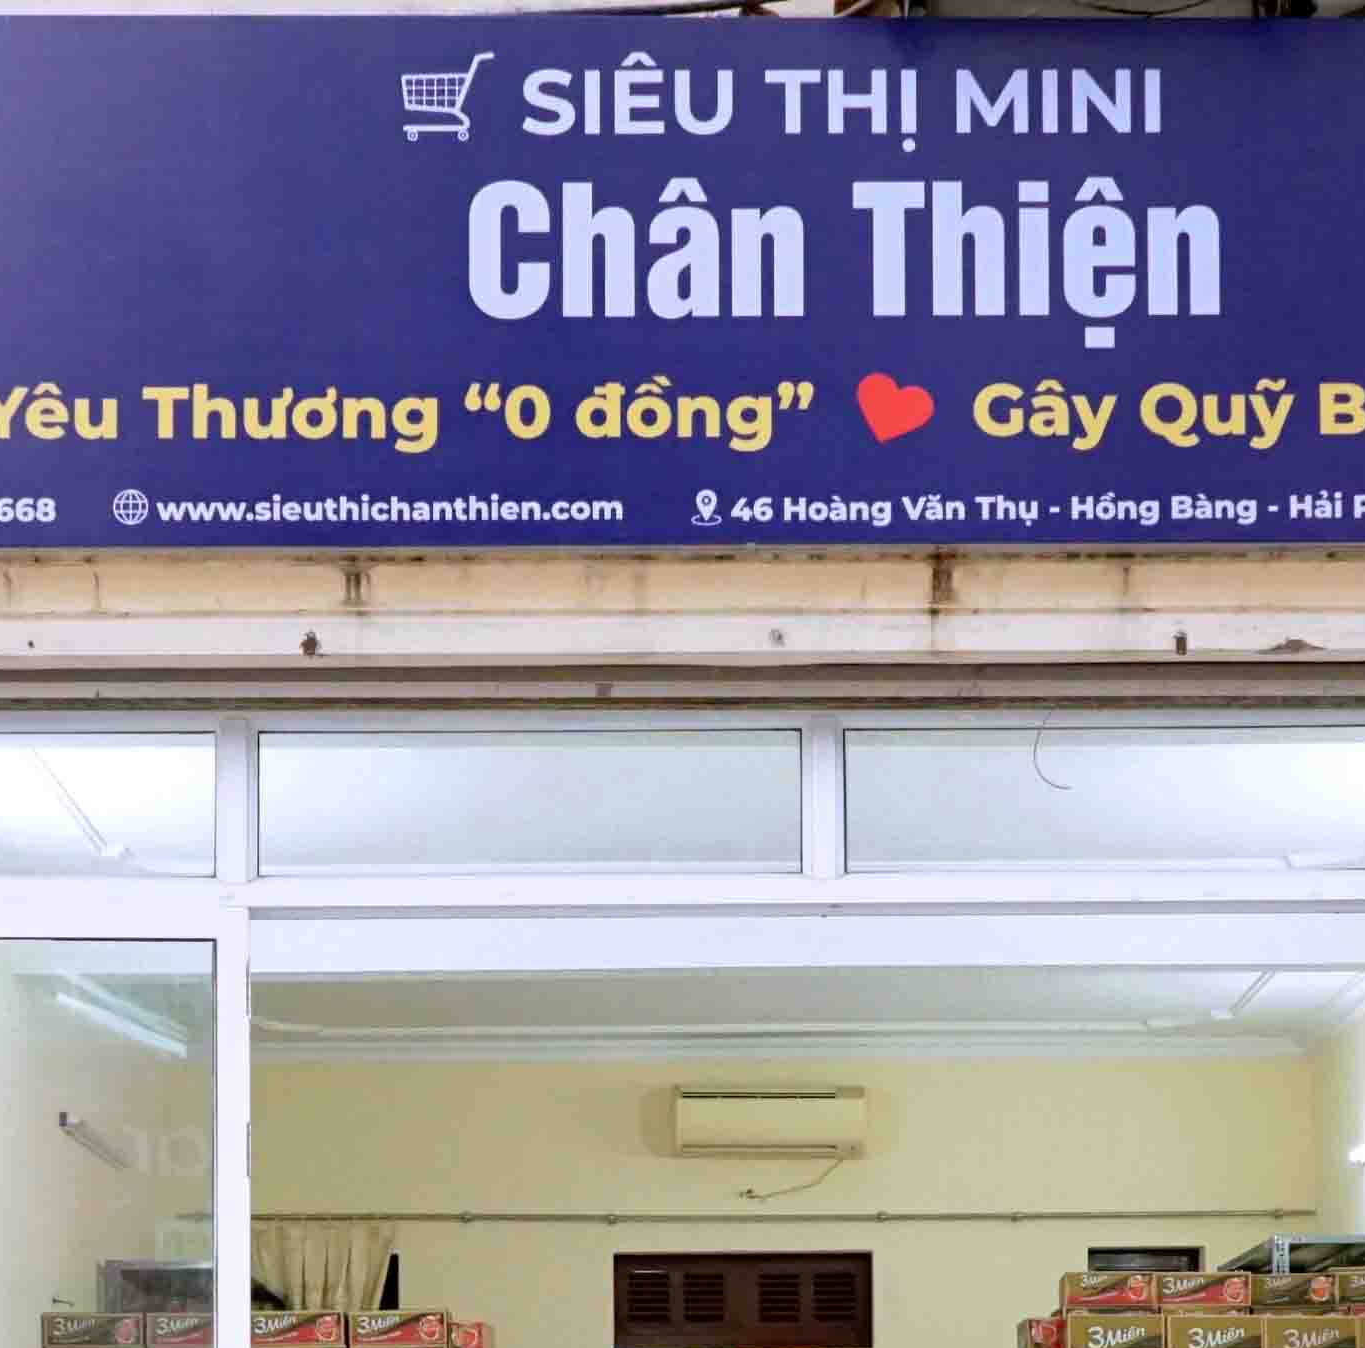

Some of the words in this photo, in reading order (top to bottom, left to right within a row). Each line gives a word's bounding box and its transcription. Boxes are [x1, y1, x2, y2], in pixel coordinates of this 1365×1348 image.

[523, 52, 733, 135] SIÊU
[765, 69, 917, 152] THỊ
[956, 69, 1161, 134] MINI
[469, 177, 804, 319] Chân
[853, 177, 1220, 348] Thiện
[142, 384, 438, 453] Thương
[973, 379, 1117, 450] Gây
[1140, 379, 1294, 449] Quỹ
[156, 493, 623, 521] www.sieuthichanthien.com
[731, 497, 773, 522] 46
[784, 496, 891, 526] Hoàng
[902, 494, 965, 520] Văn
[975, 495, 1038, 526] Thụ
[1071, 492, 1159, 525] Hồng
[1171, 494, 1257, 525] Bàng
[1290, 490, 1342, 518] Hải
